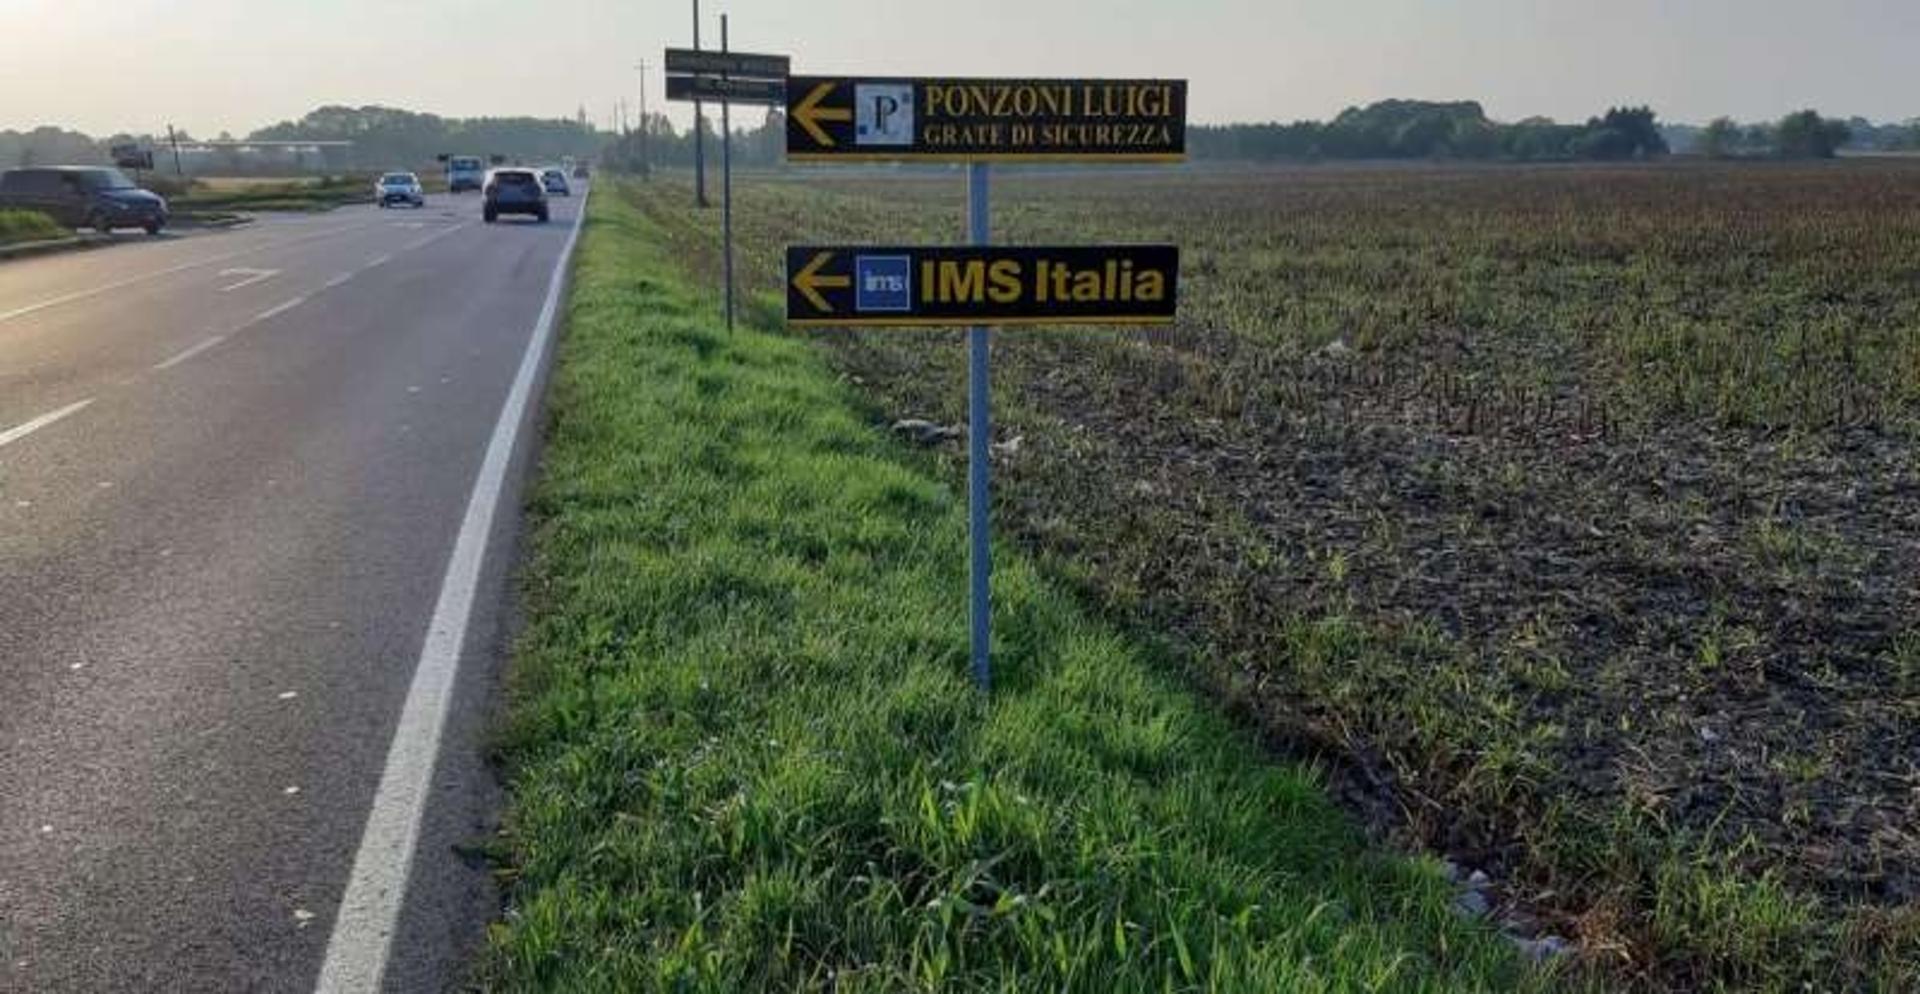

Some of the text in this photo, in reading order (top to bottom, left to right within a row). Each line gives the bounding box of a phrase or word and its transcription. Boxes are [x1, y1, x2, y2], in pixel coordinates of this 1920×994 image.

[925, 84, 1173, 117] PONZONI LUIGI
[923, 124, 1173, 146] GRATE DI SICUREZZA
[920, 258, 1166, 303] IMS Italia
